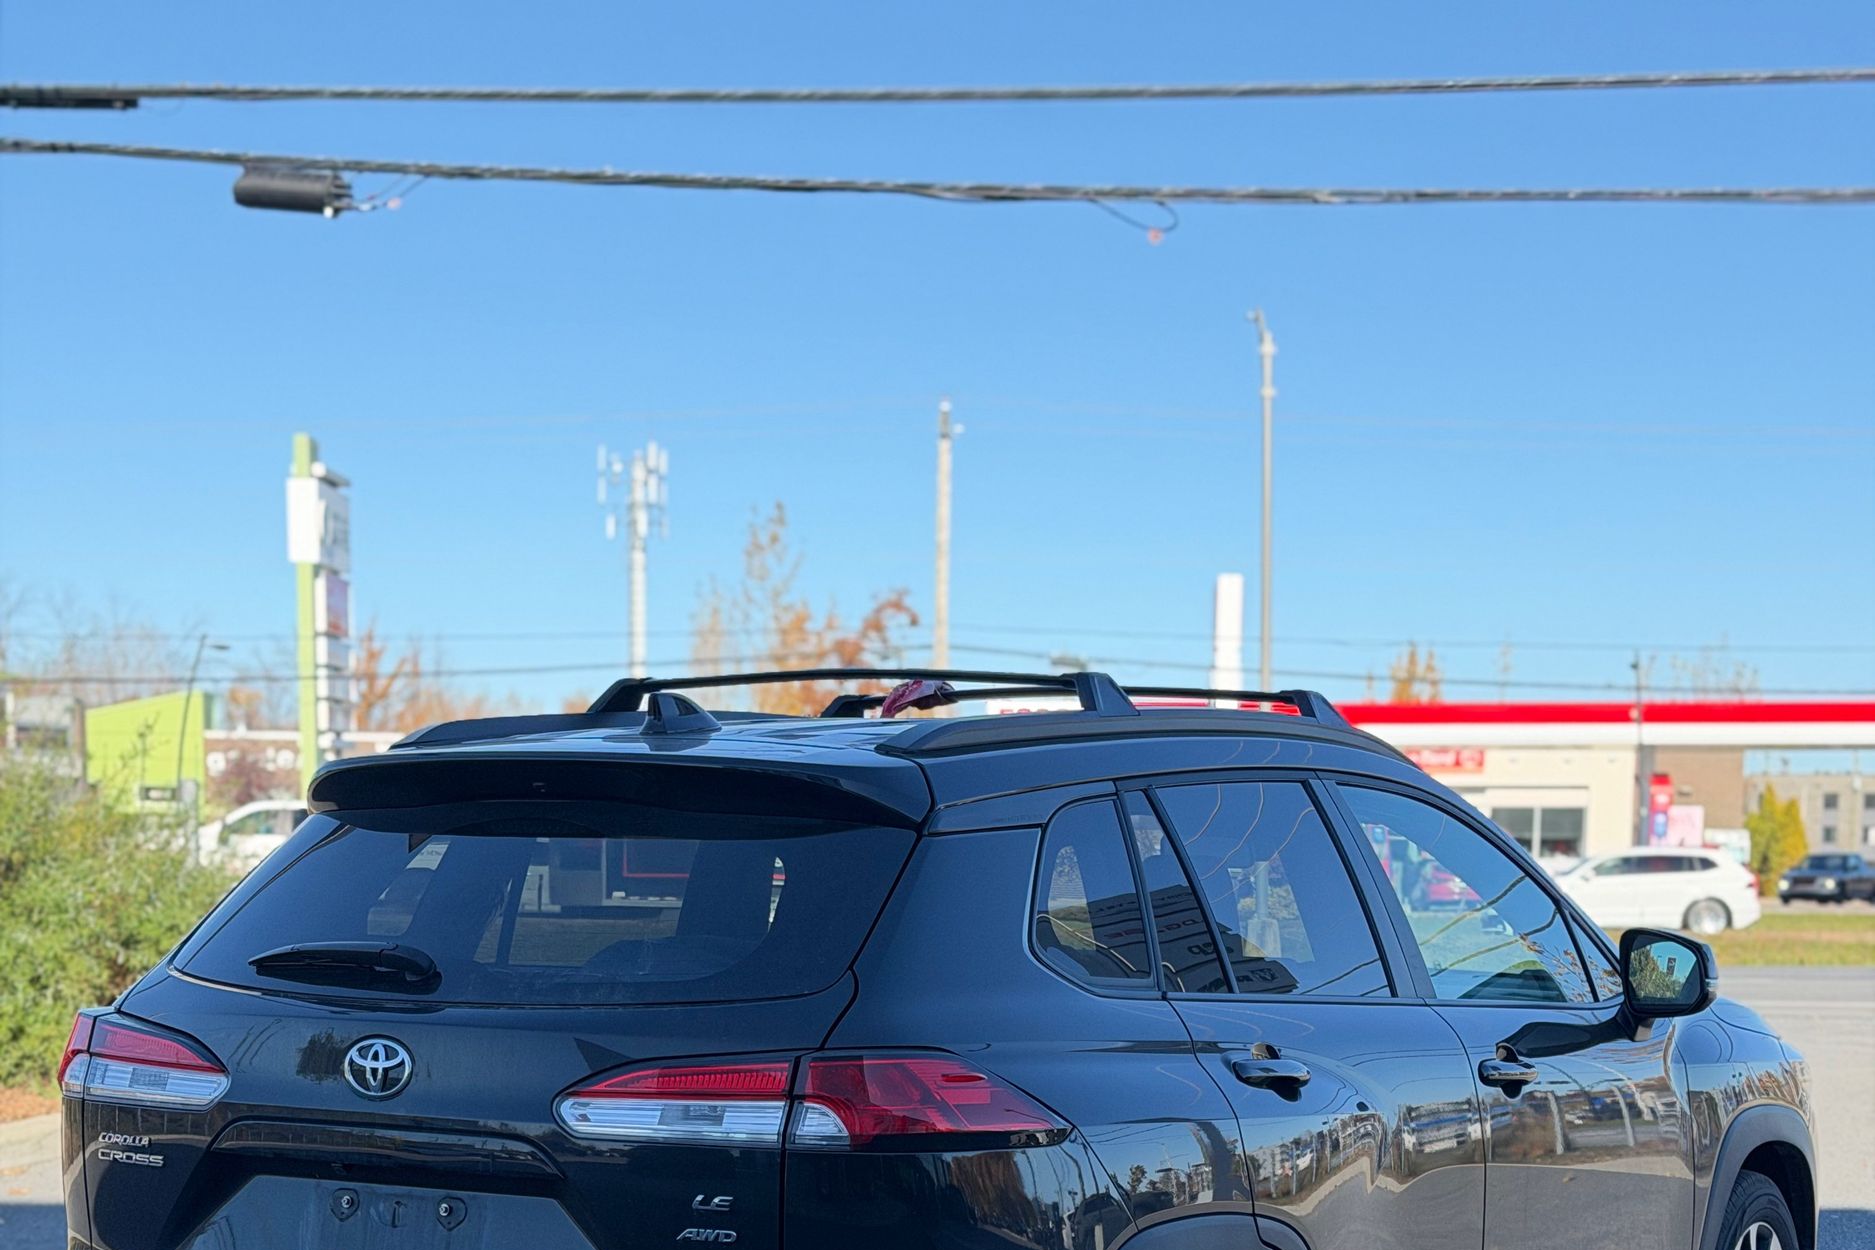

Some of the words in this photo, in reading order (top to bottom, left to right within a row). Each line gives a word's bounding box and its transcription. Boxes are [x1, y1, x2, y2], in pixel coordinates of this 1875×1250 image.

[98, 1132, 149, 1148] COROLLA
[98, 1149, 164, 1166] CROSS
[692, 1194, 734, 1211] LE
[676, 1228, 737, 1243] AWD
